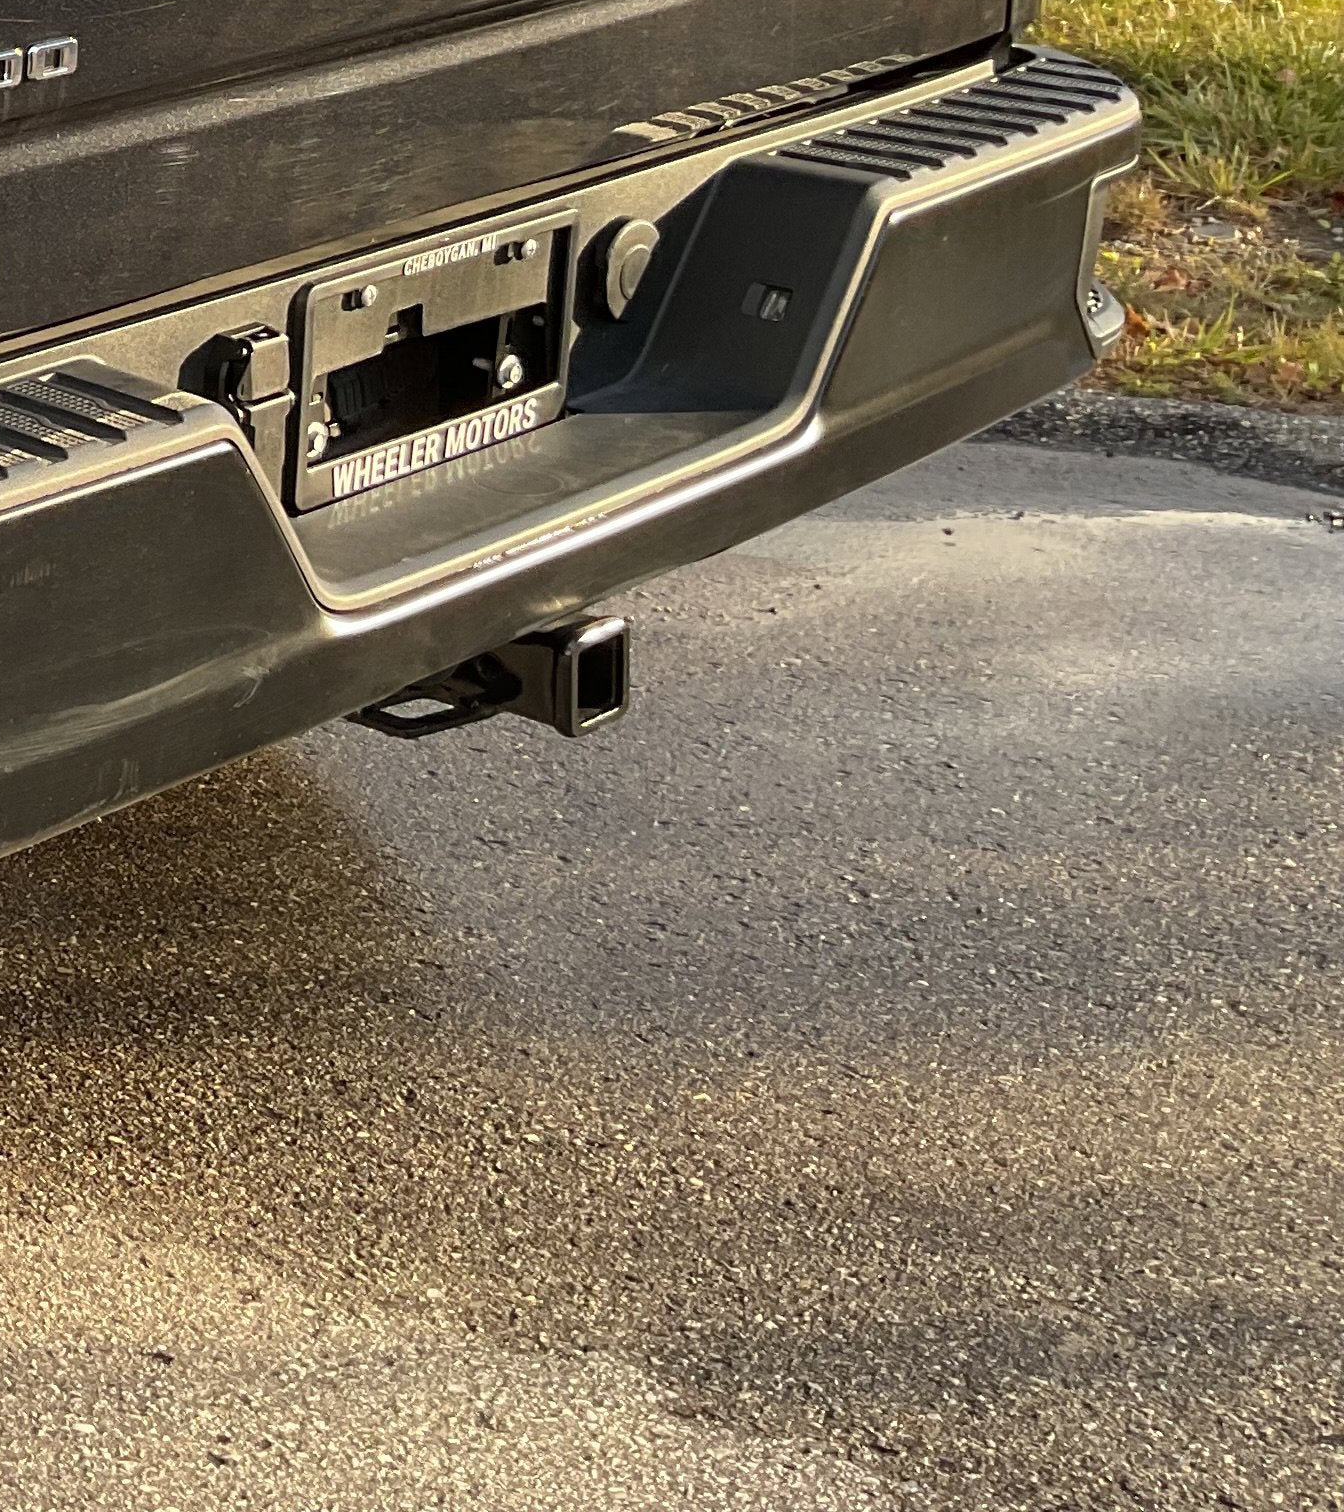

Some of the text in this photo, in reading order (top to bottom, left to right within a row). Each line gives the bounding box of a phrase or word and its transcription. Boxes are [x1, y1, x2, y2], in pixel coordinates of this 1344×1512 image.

[403, 234, 497, 276] CHEBOYGAN, MI
[332, 397, 538, 497] WHEELER MOTORS
